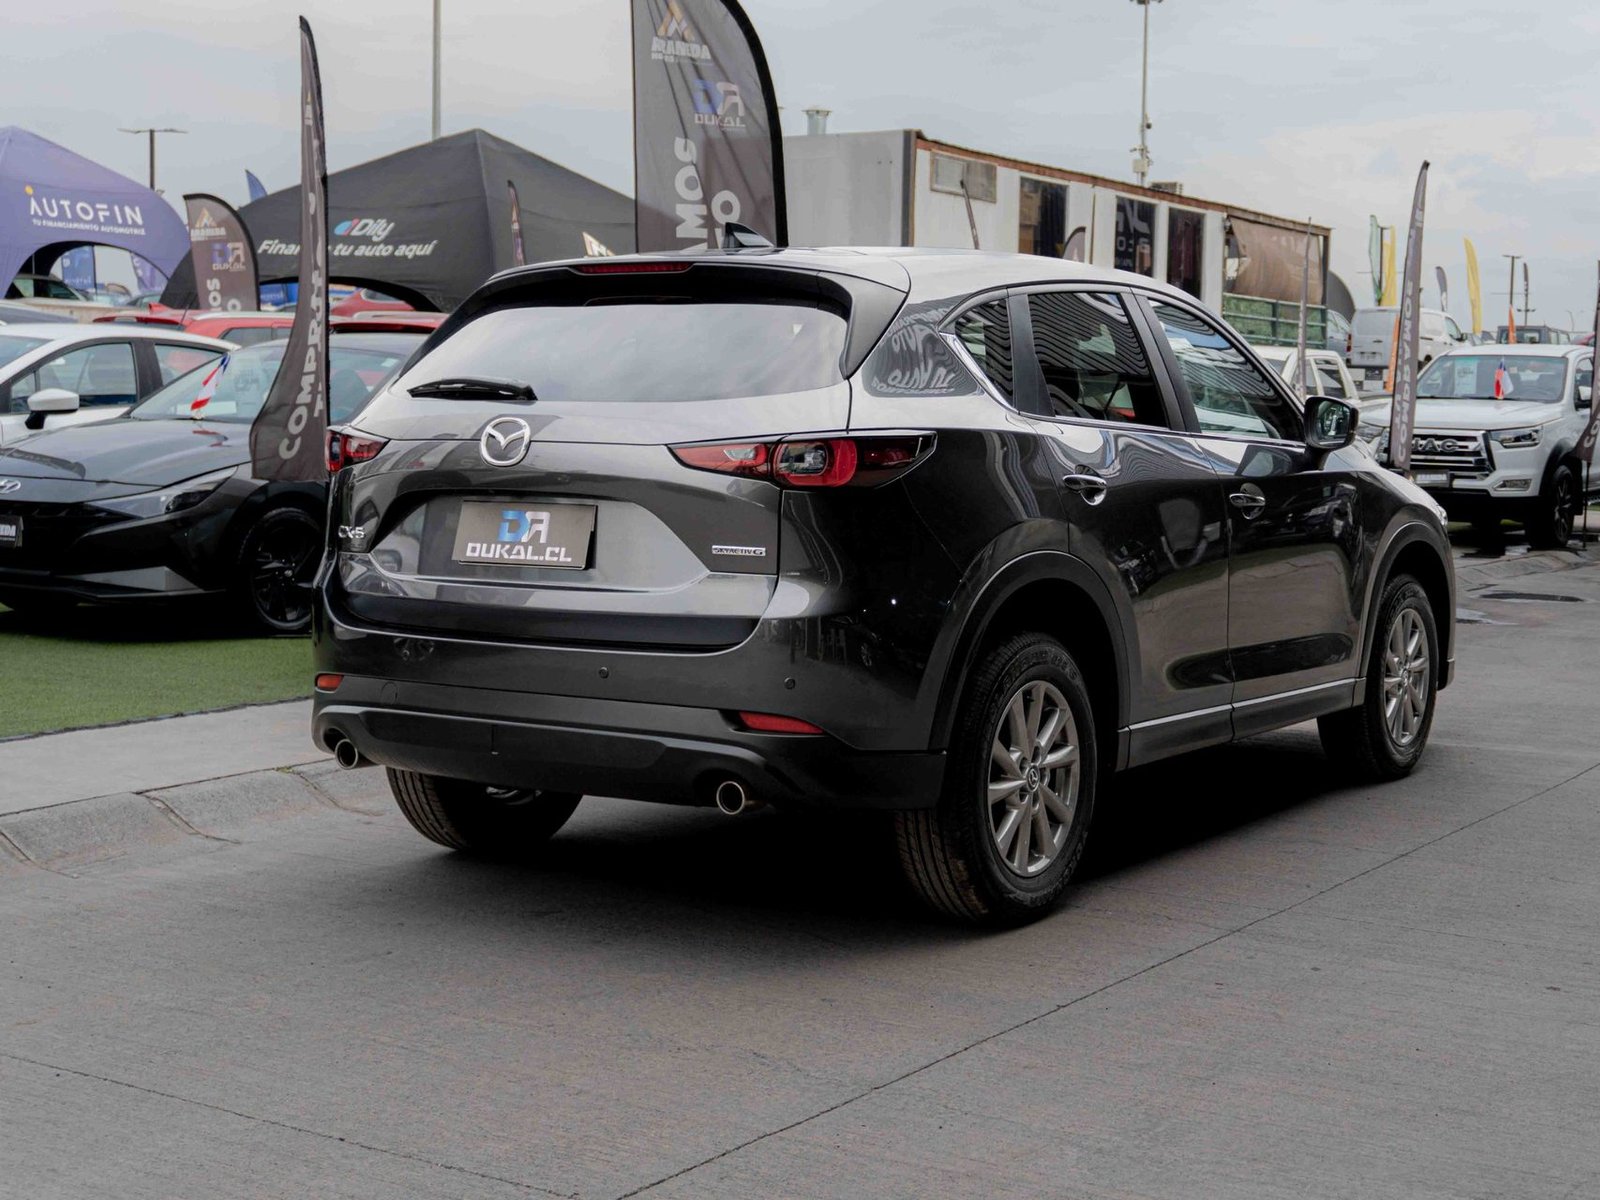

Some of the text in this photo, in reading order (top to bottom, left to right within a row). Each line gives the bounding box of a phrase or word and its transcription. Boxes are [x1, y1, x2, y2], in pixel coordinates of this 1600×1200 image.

[694, 113, 746, 128] DUKAL
[30, 197, 143, 226] AUTOFIN
[351, 219, 395, 242] Dily
[333, 243, 353, 256] tu
[354, 244, 391, 257] auto
[394, 240, 438, 259] aquí
[465, 542, 572, 562] DUKAL.CL
